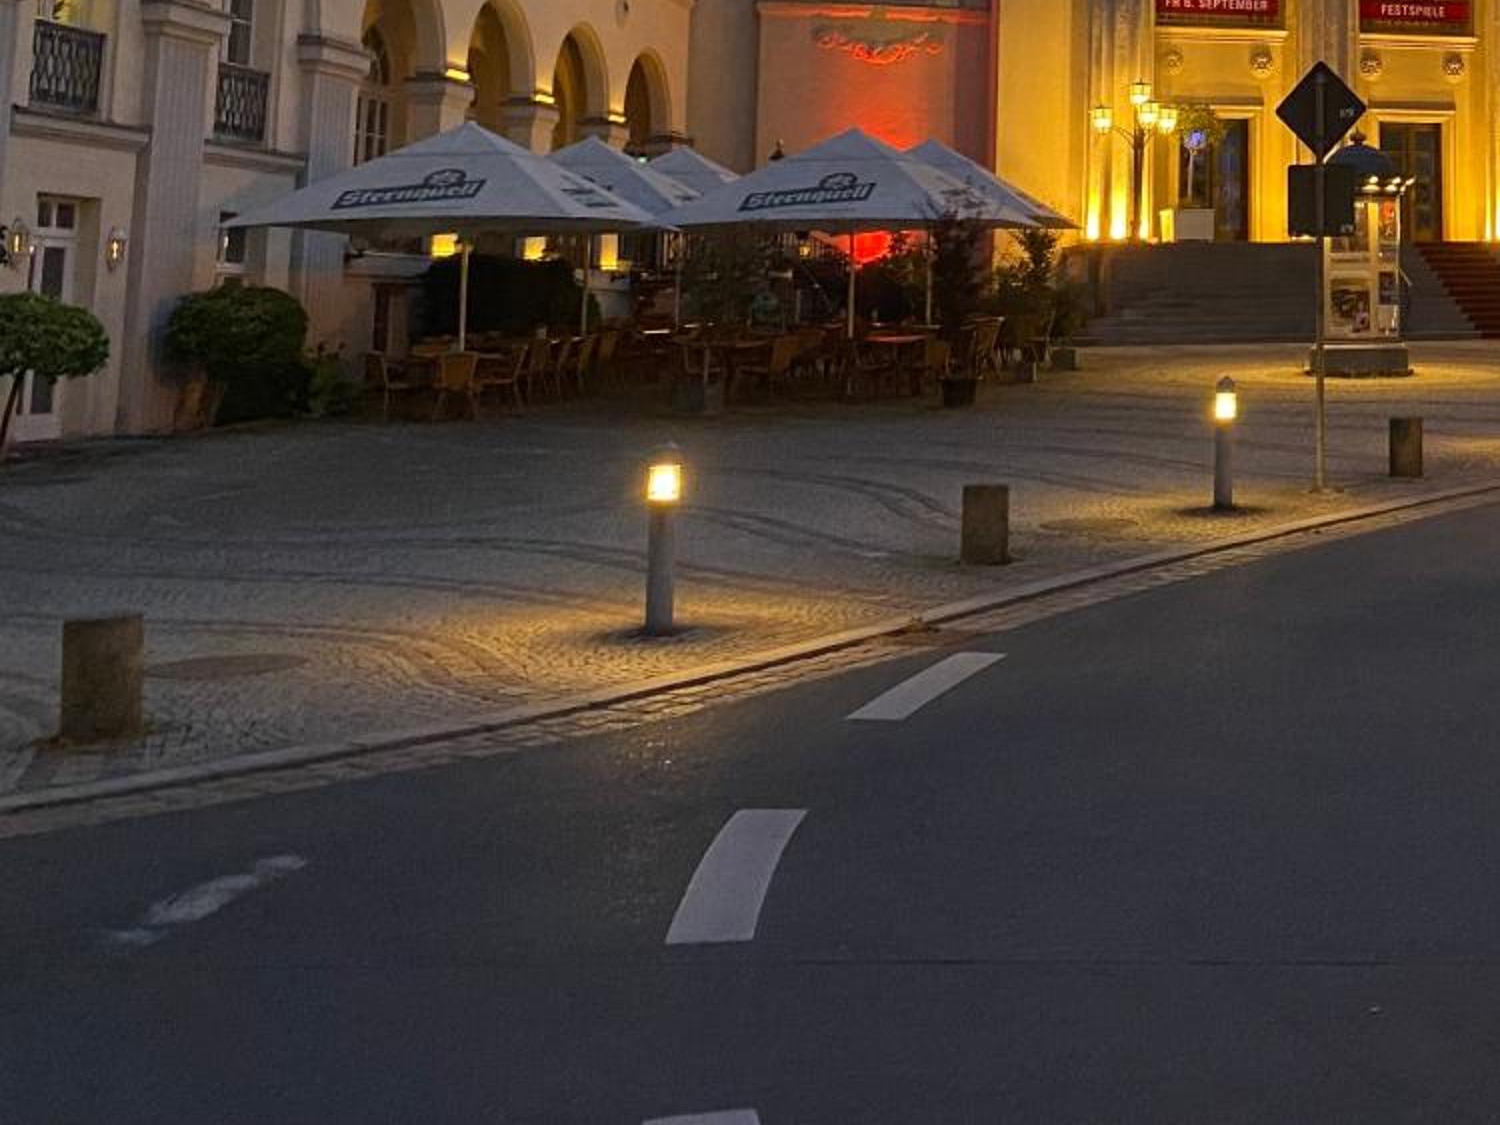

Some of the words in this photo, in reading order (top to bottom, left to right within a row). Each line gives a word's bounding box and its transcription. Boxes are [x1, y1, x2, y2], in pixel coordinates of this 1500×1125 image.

[1381, 3, 1445, 18] FESTSPIELE
[339, 179, 480, 208] Sternquell
[747, 183, 870, 209] Sternquell
